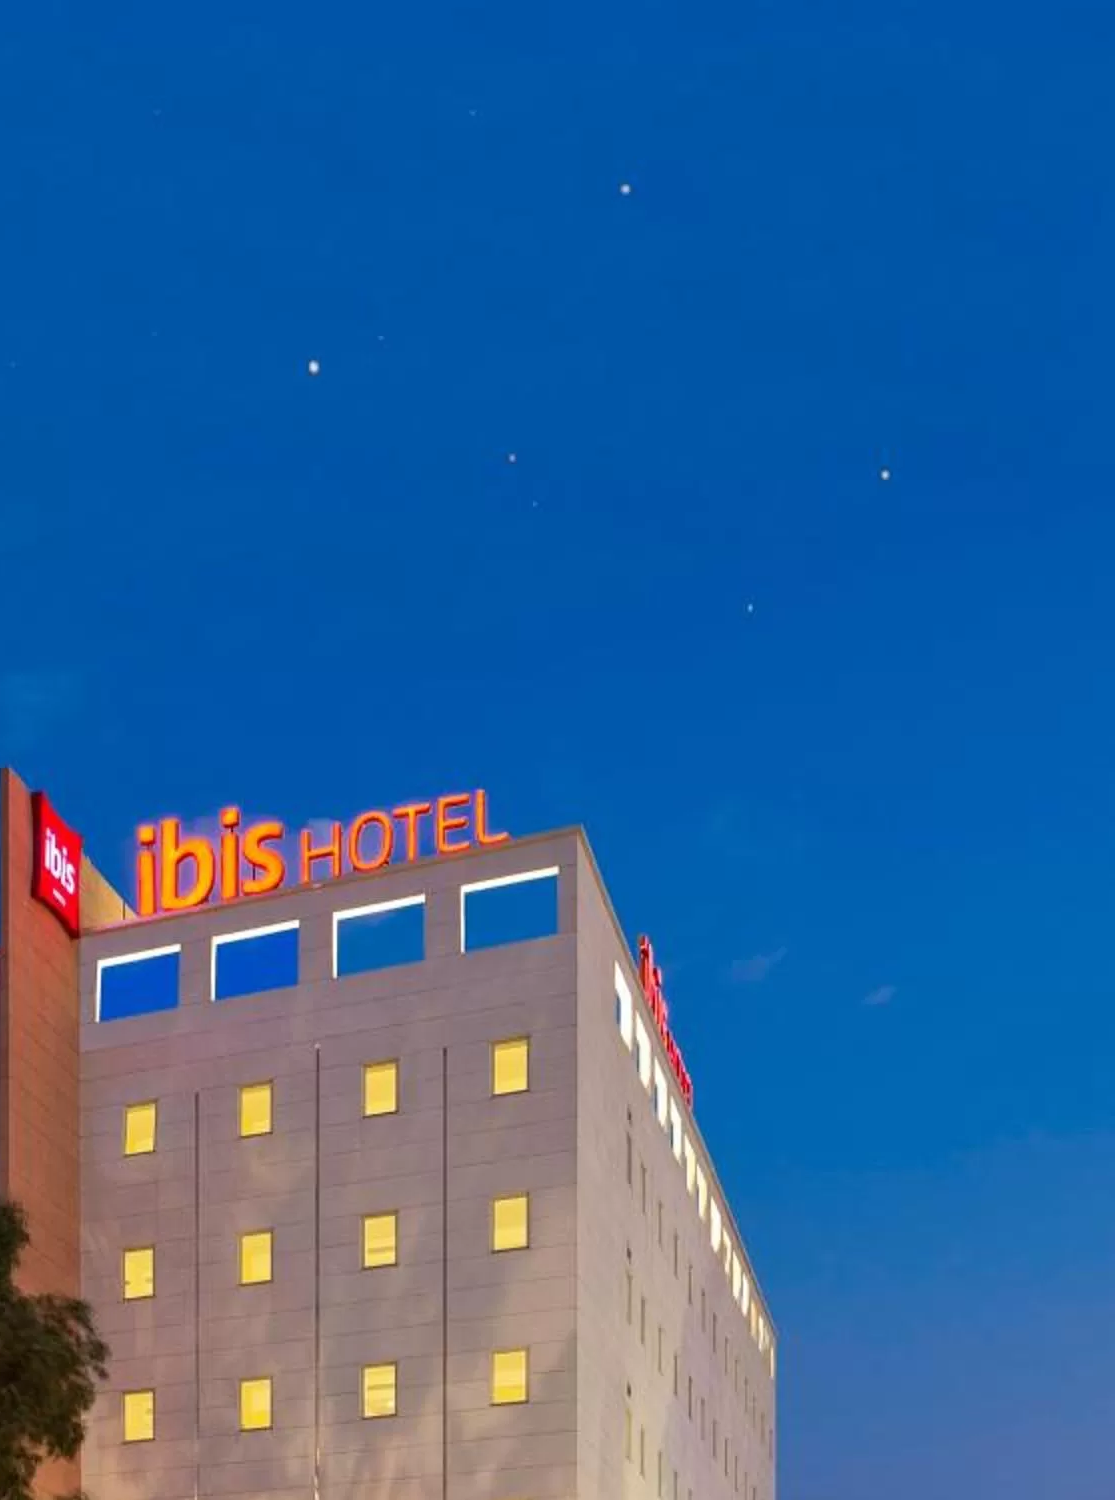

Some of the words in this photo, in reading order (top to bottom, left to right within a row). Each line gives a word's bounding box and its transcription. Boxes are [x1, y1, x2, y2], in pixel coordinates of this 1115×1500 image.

[45, 827, 75, 894] ibis
[135, 806, 286, 918] ibis
[299, 789, 509, 886] HOTEL
